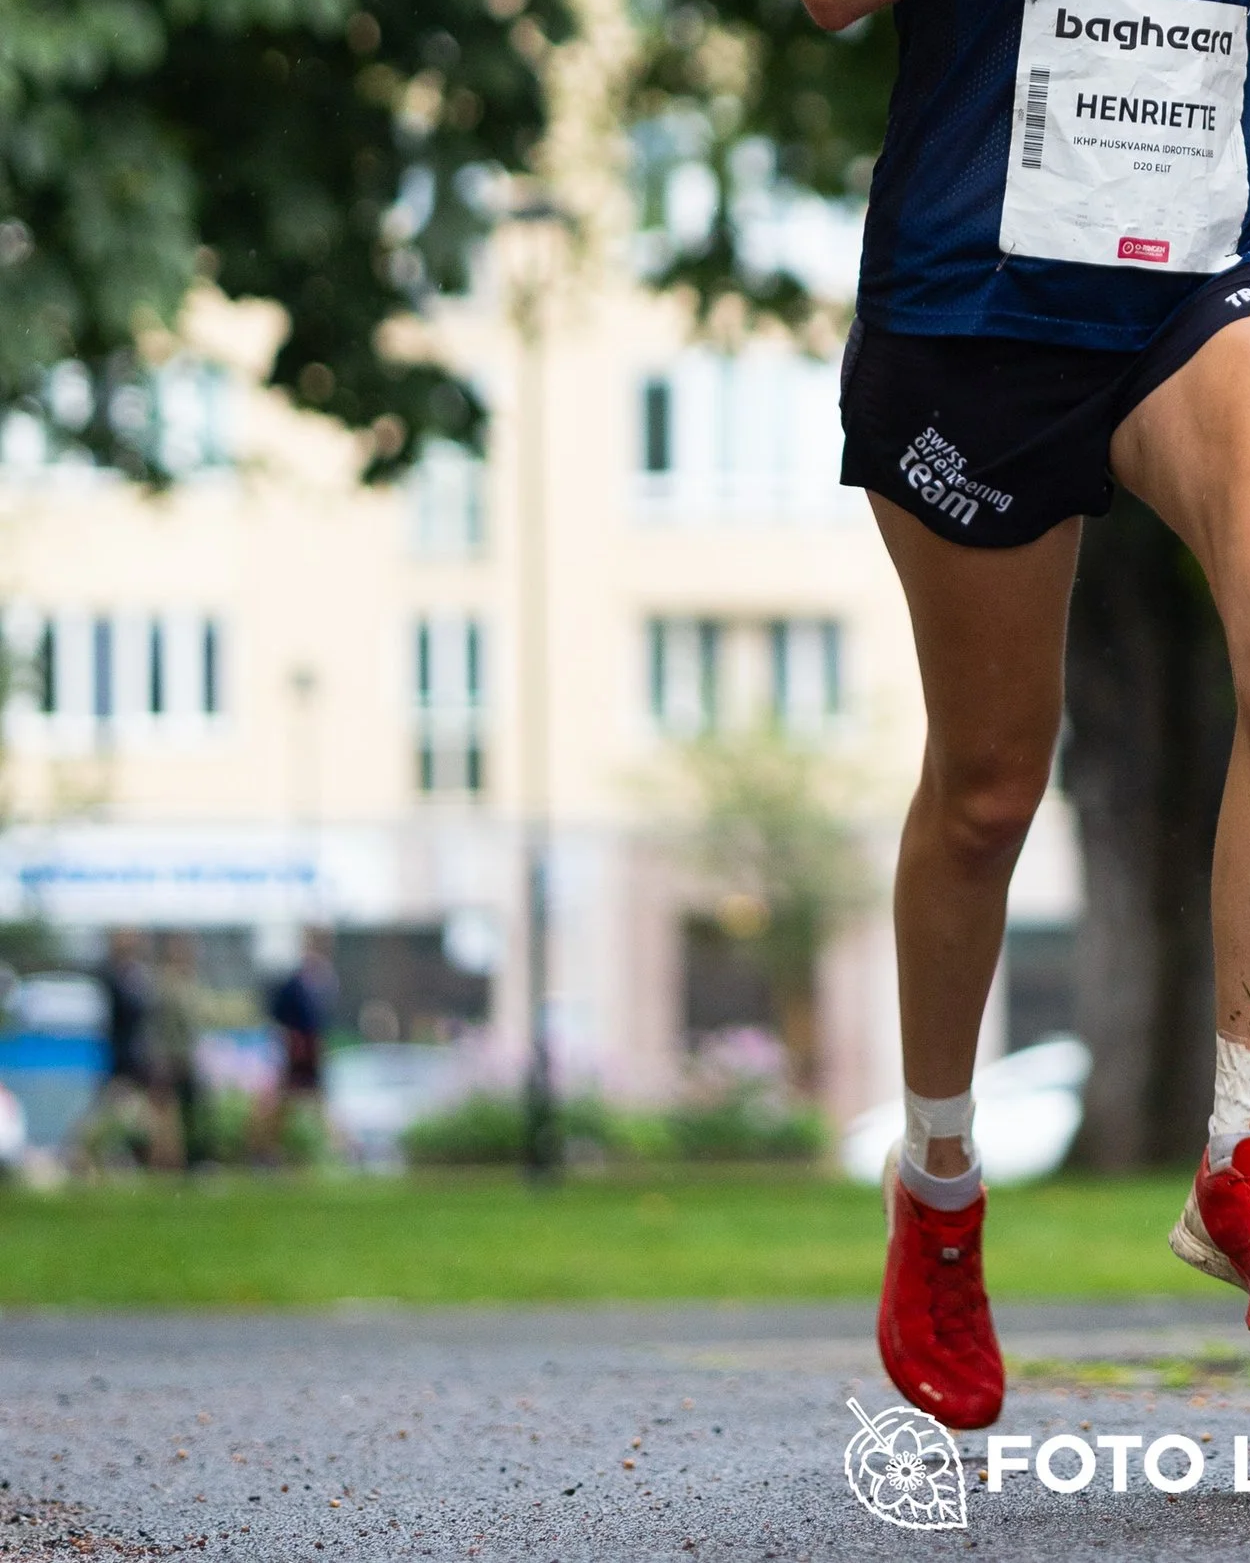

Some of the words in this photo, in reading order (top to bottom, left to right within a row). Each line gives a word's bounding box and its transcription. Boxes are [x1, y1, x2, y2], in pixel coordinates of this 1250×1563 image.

[1055, 8, 1233, 56] bagheera
[1076, 93, 1216, 131] HENRIETTE
[1073, 136, 1097, 147] IKHP
[1100, 139, 1160, 153] HUSKVARNA
[1133, 161, 1153, 172] D20
[1155, 163, 1172, 174] ELIT
[922, 427, 967, 470] swiss
[899, 445, 979, 525] team
[915, 436, 1013, 512] orienteering
